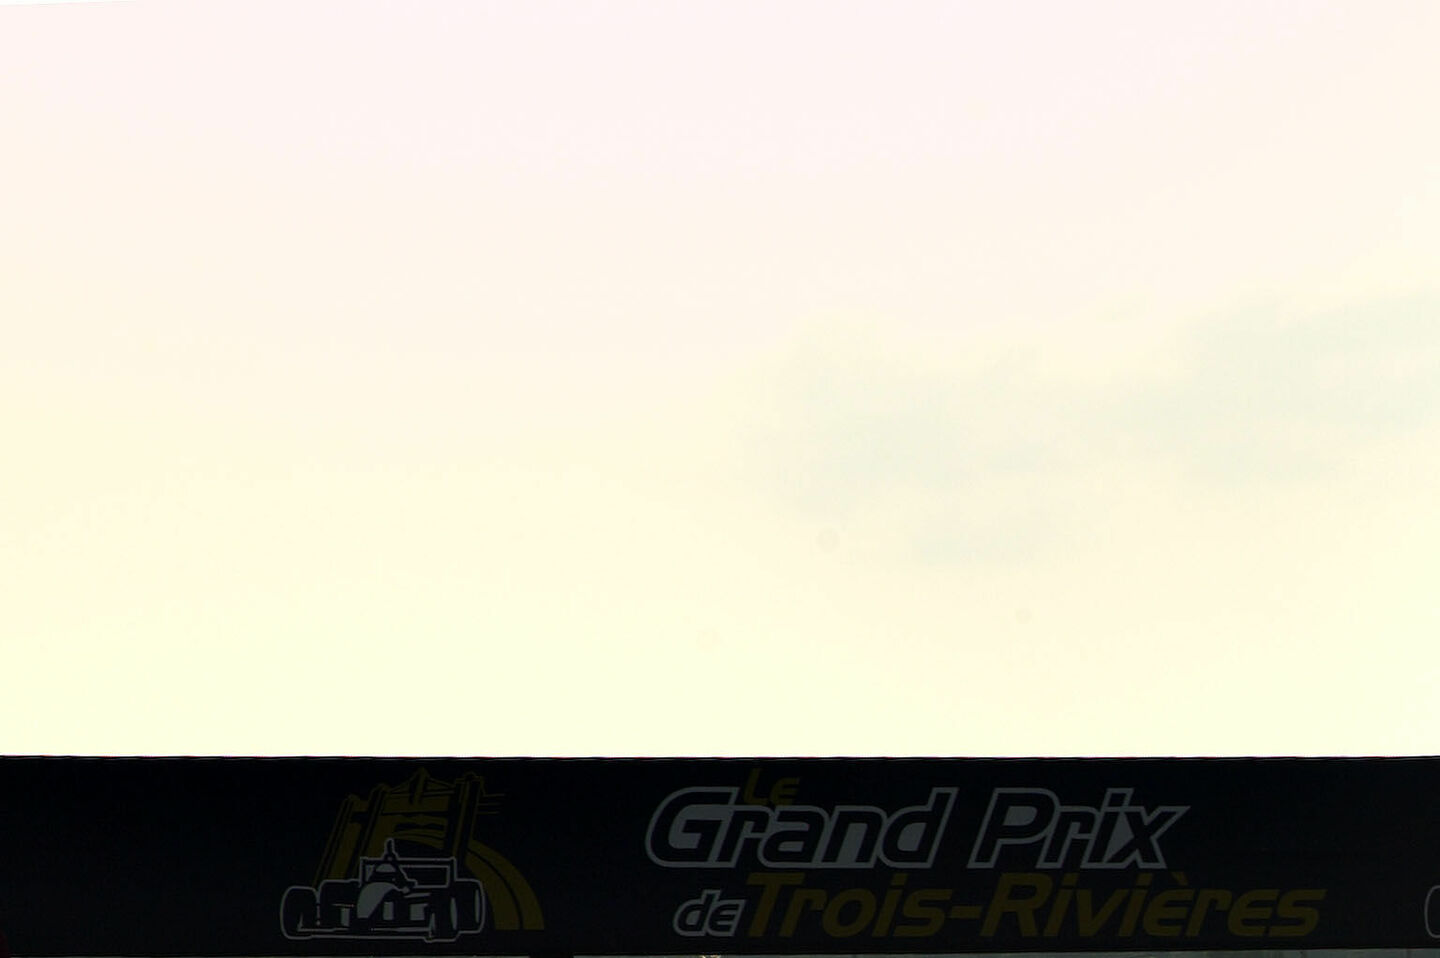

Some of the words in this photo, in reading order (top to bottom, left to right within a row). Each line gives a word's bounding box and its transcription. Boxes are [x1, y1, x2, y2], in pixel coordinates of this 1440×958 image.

[645, 786, 959, 868] Grand
[967, 787, 1191, 869] Prix
[745, 871, 1328, 938] Trois-Rivières
